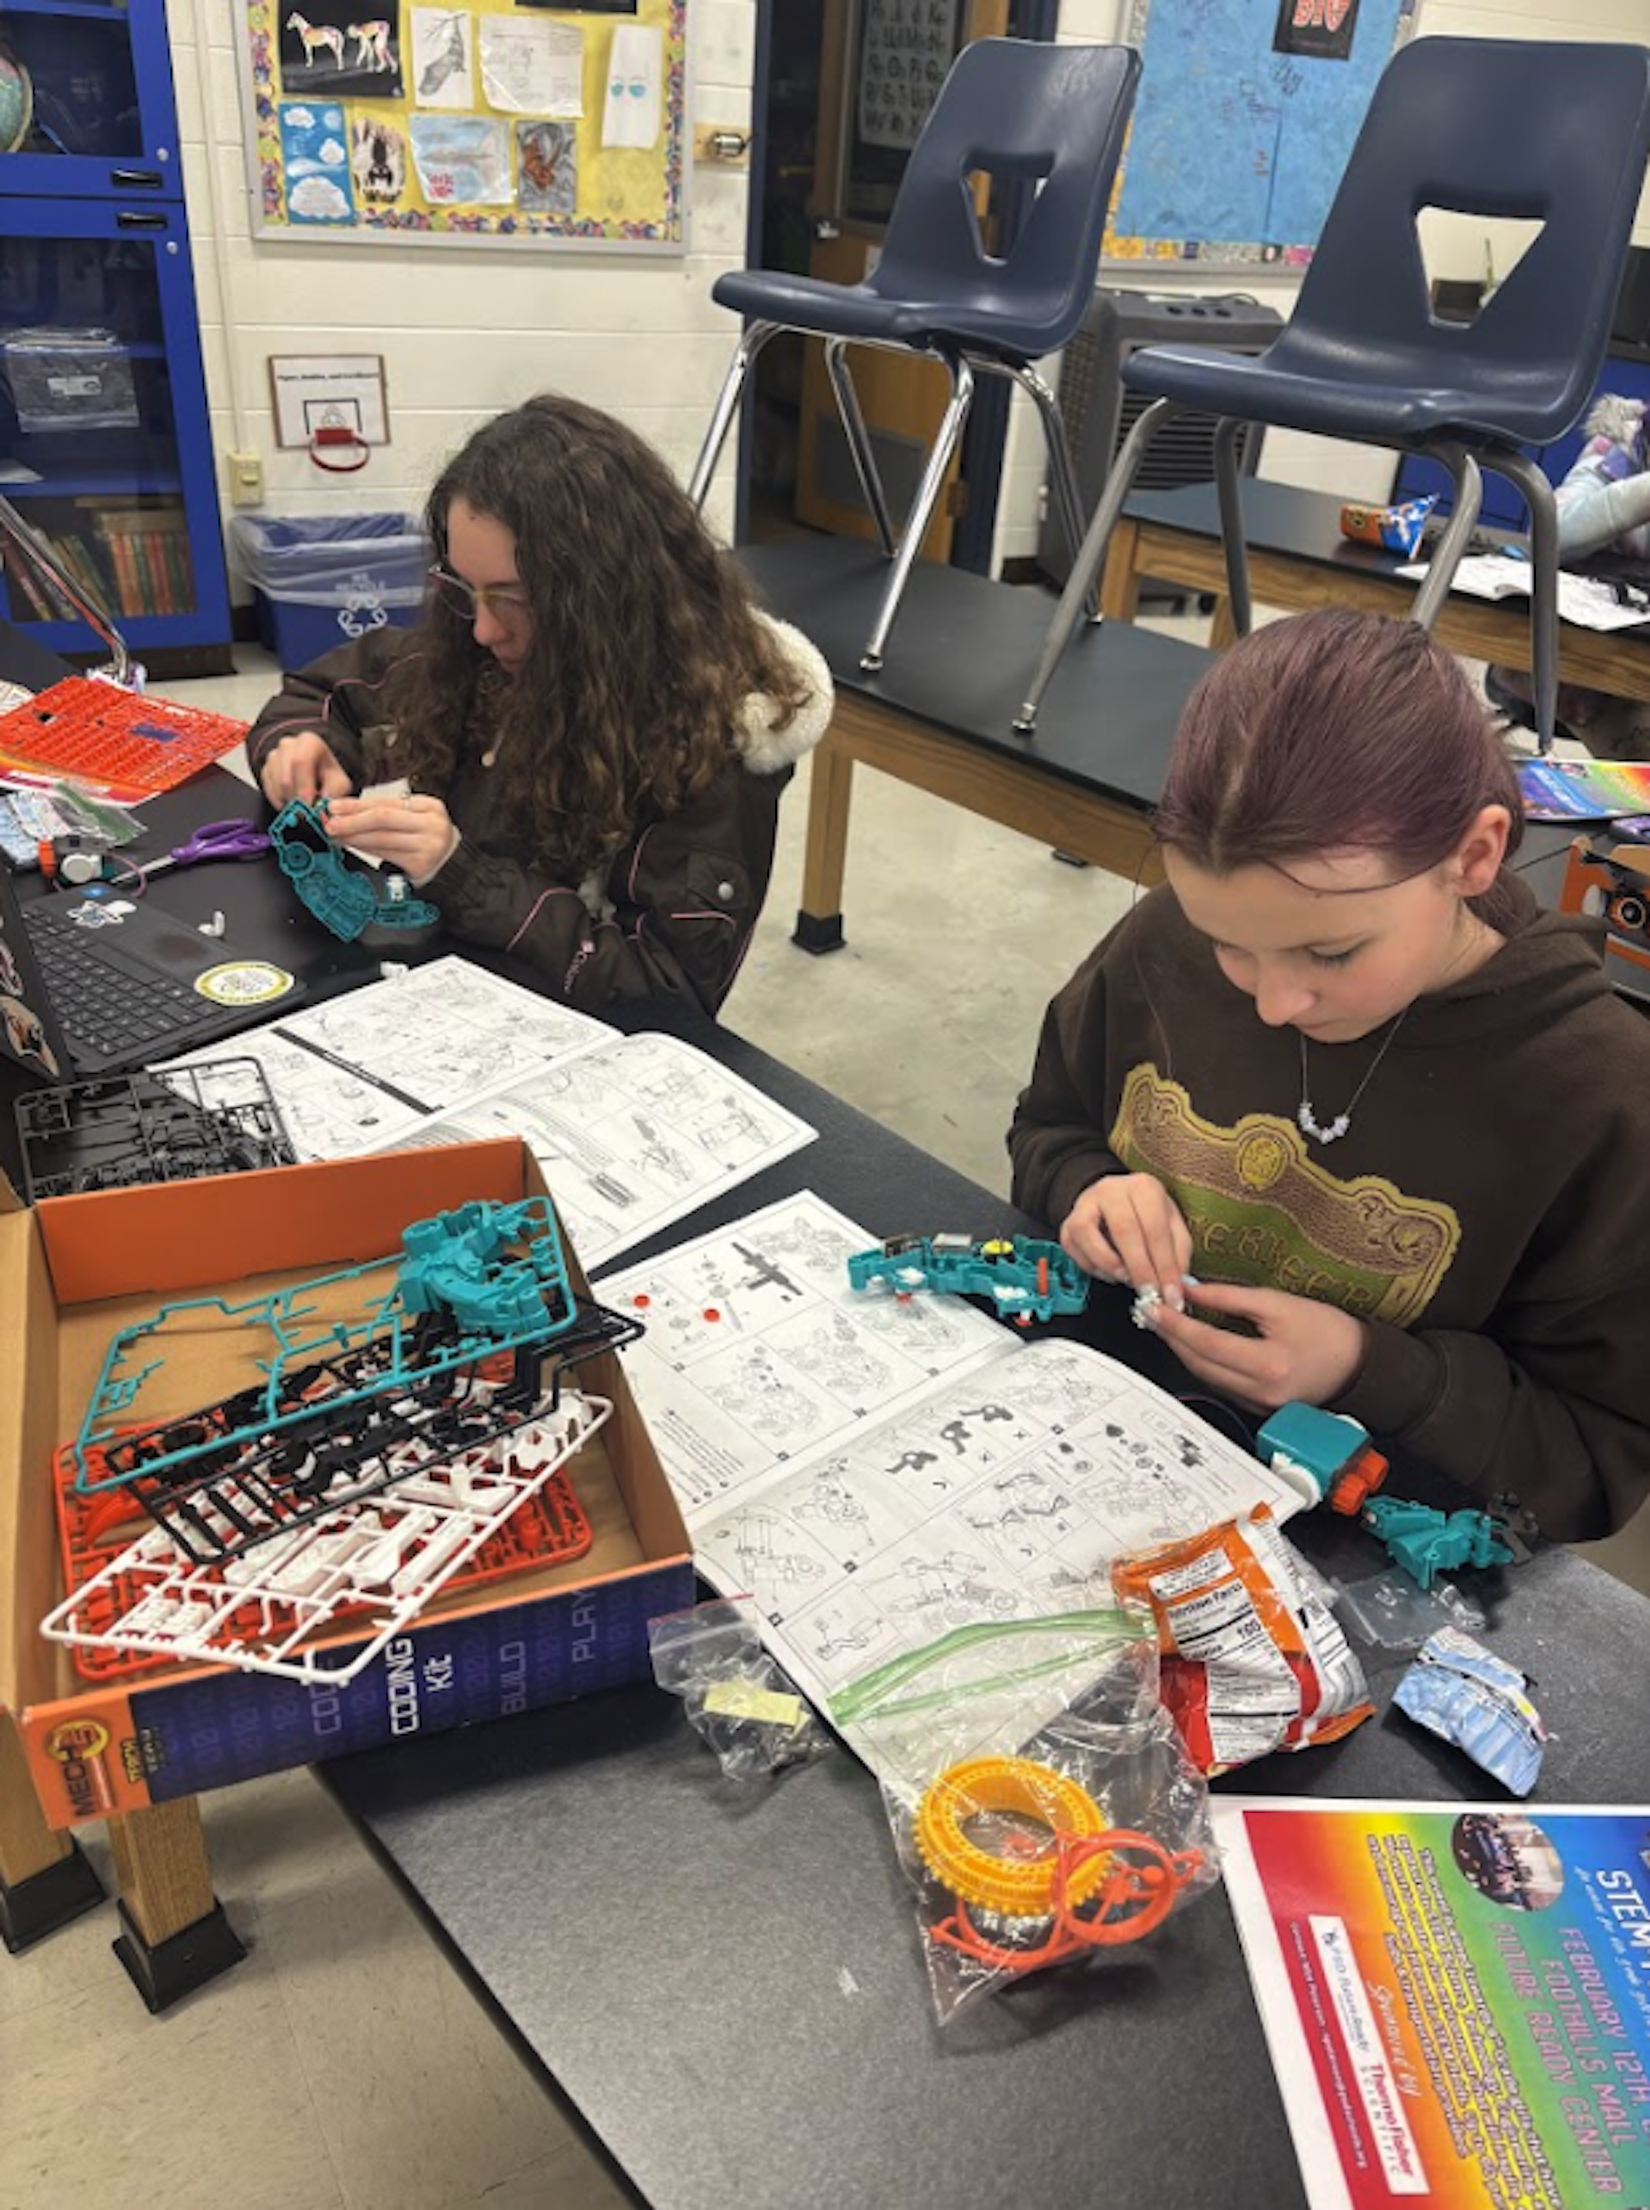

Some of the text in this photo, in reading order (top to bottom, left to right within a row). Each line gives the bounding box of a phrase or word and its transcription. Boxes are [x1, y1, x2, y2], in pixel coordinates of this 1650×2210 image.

[571, 1590, 598, 1662] PLAY
[308, 1655, 342, 1735] COD
[385, 1637, 420, 1735] CODING
[423, 1654, 453, 1692] Kit
[501, 1641, 527, 1715] BUILD
[1429, 1912, 1447, 1944] STEM
[1595, 1869, 1650, 1948] STEM
[1557, 1928, 1628, 2037] FEBRUARY
[1433, 2020, 1453, 2059] STEM
[1438, 1986, 1477, 2074] environment
[1484, 2114, 1501, 2140] will
[1488, 1921, 1623, 2195] FUTURE READY CENTER
[1537, 1958, 1638, 2149] FOOTHILLS MALL
[1359, 2066, 1401, 2175] SCIENTIFIC
[1368, 2063, 1415, 2177] Thermo Fisher
[1398, 2072, 1422, 2097] by
[1495, 2050, 1518, 2093] Grade
[1508, 2095, 1531, 2130] girls
[1526, 2132, 1545, 2165] that
[1539, 2169, 1560, 2207] have
